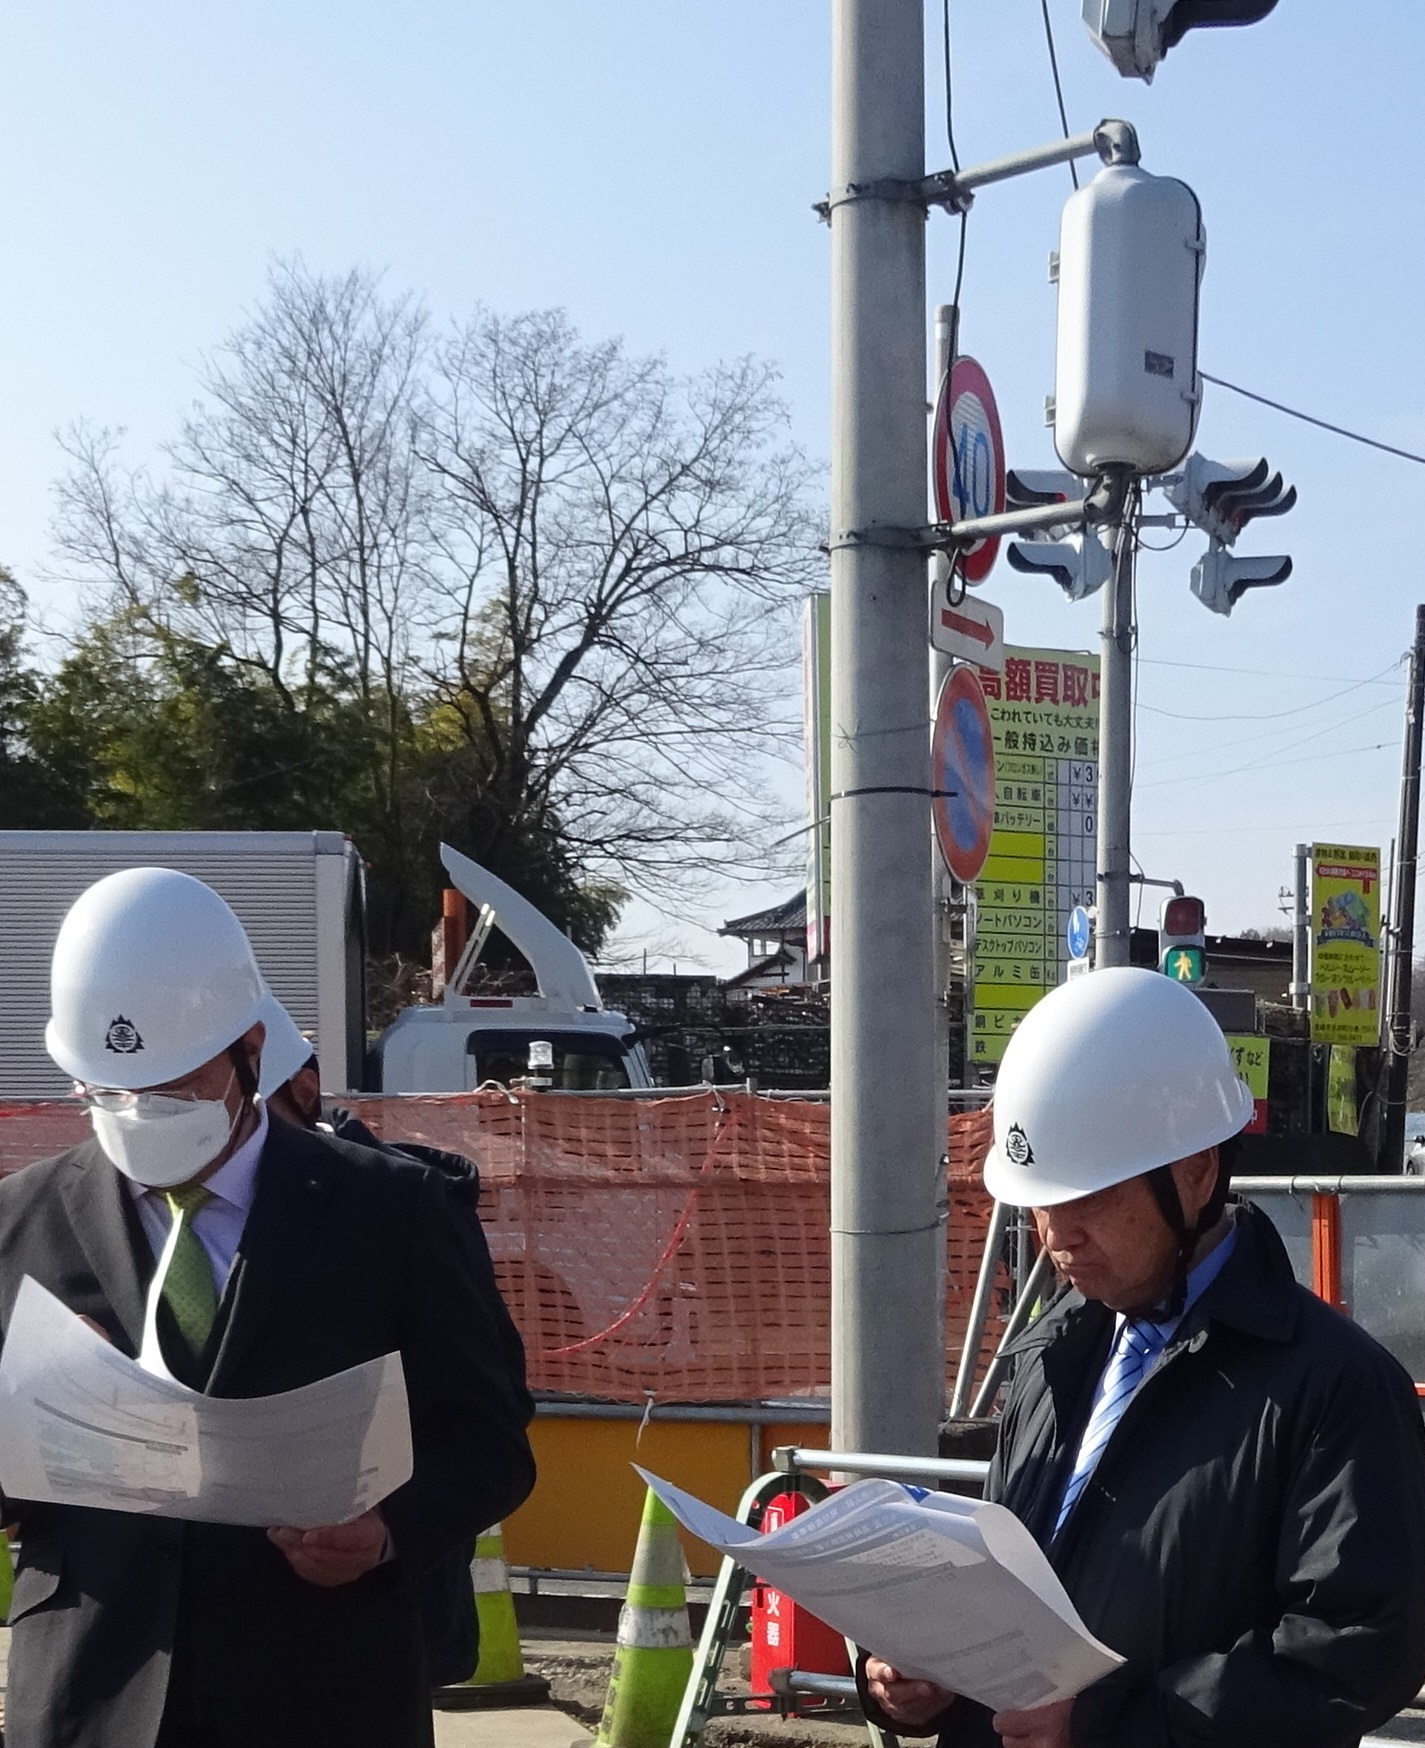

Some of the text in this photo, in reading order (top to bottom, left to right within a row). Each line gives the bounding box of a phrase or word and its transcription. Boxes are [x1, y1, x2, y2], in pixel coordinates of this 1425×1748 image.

[952, 423, 991, 517] 40
[995, 786, 1042, 801] 自転車
[975, 964, 1040, 980] アルミ缶
